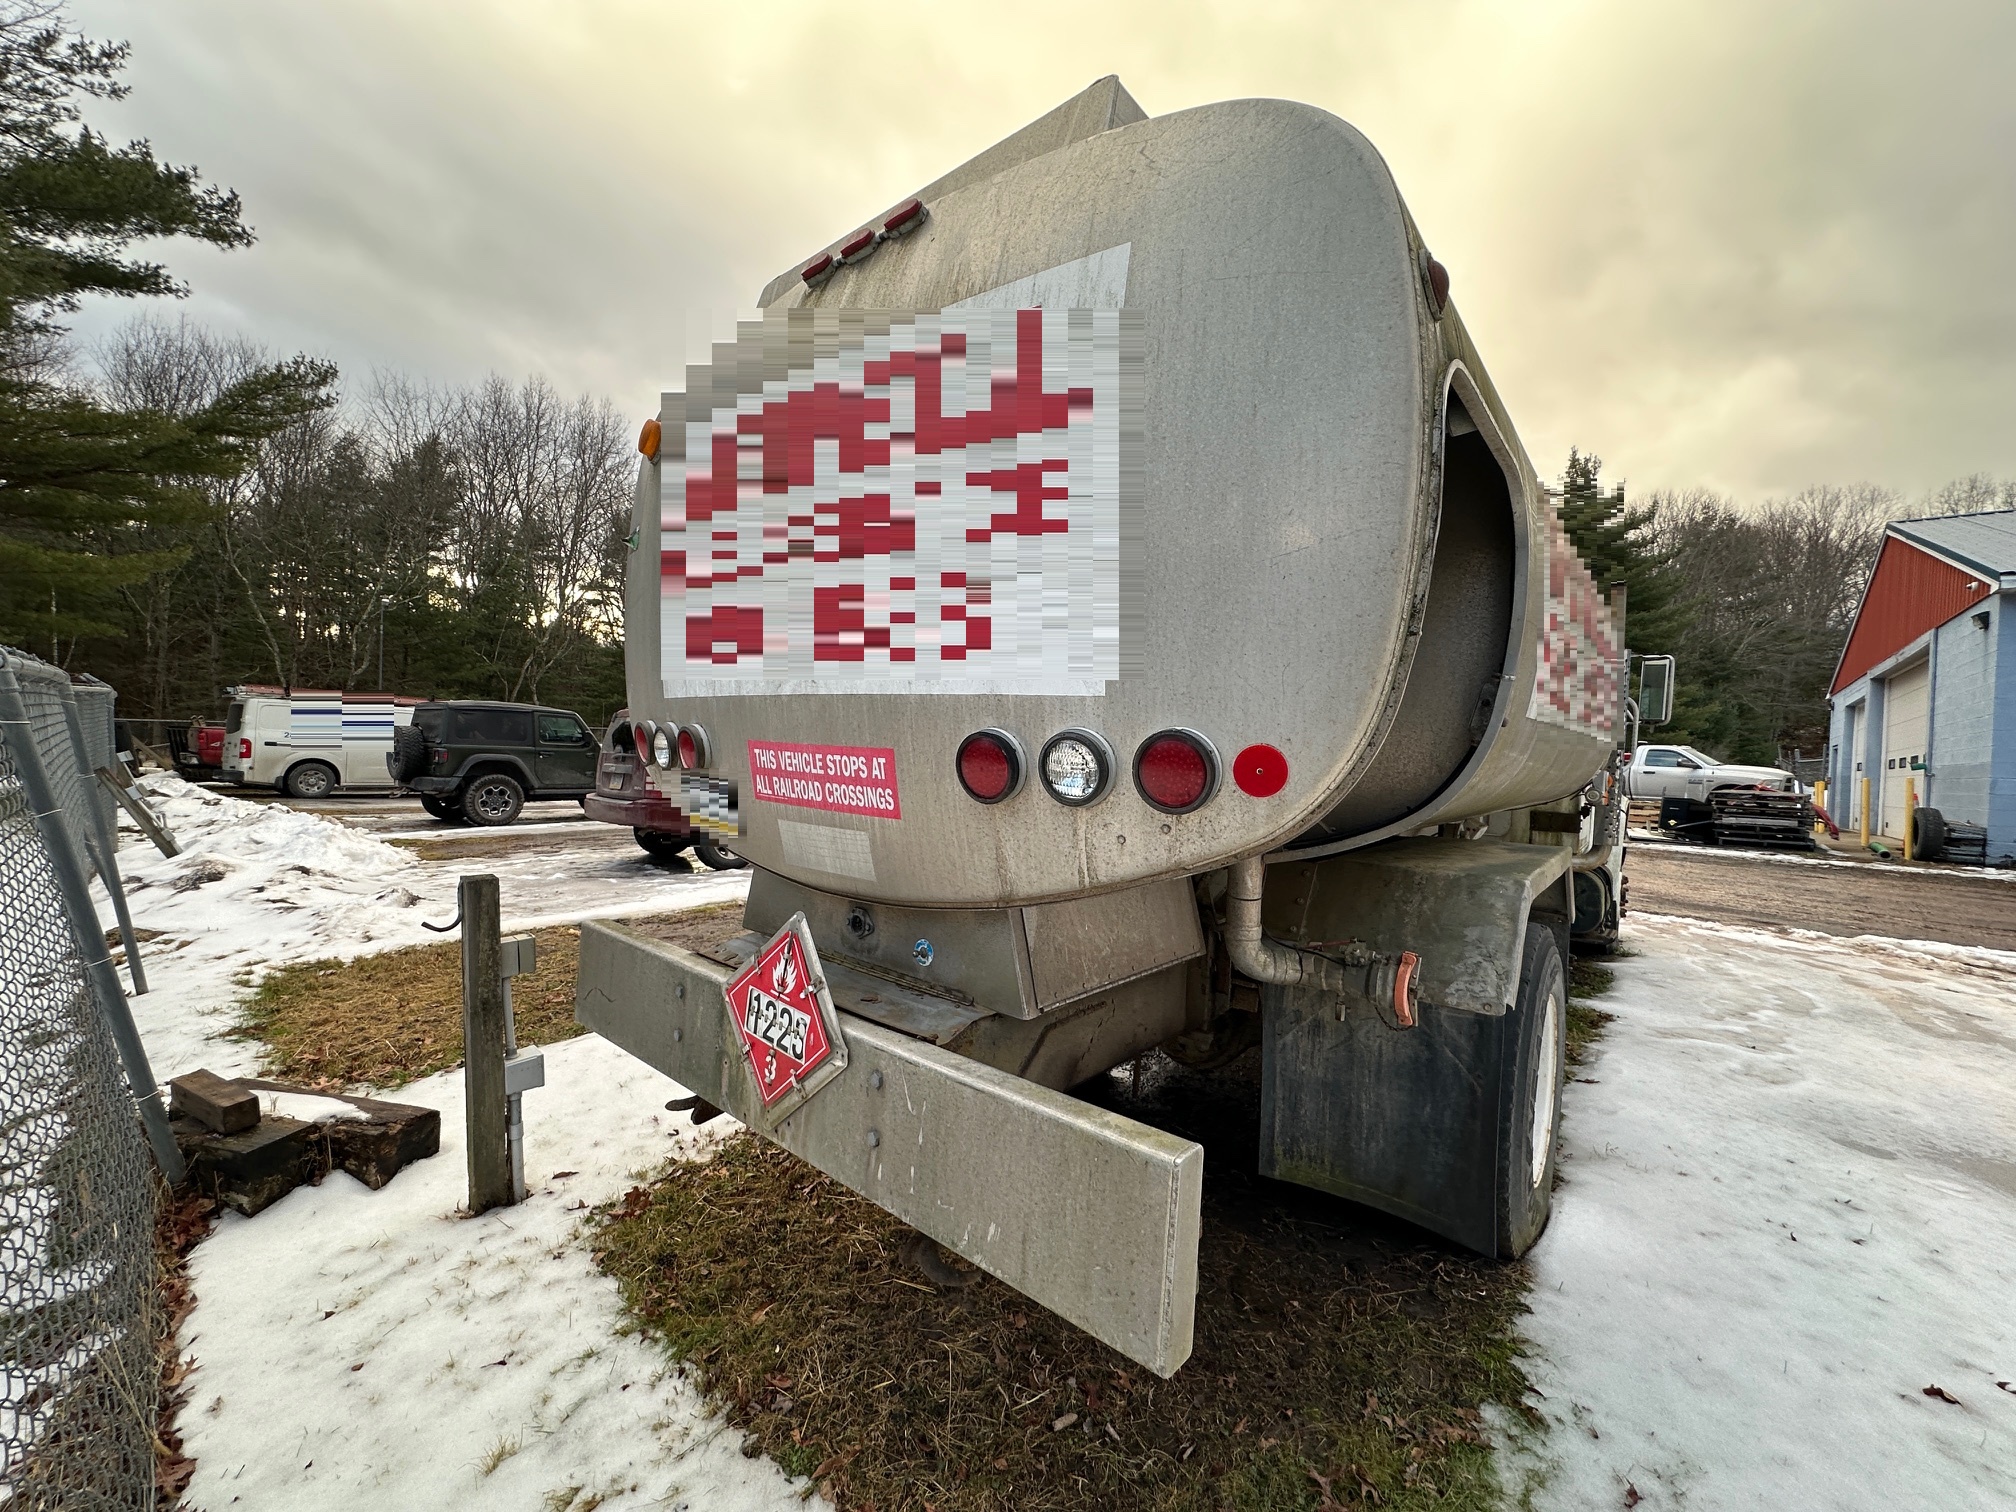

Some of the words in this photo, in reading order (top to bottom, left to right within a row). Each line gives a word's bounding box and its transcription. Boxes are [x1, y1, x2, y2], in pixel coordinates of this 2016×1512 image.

[754, 749, 776, 770] THIS
[778, 751, 824, 775] VEHICLE
[826, 754, 867, 778] STOPS
[872, 757, 886, 779] AT
[756, 774, 772, 795] ALL
[773, 776, 822, 802] RAILROAD
[825, 782, 894, 811] CROSSINGS
[753, 993, 807, 1060] 1223
[764, 1053, 777, 1081] 3
